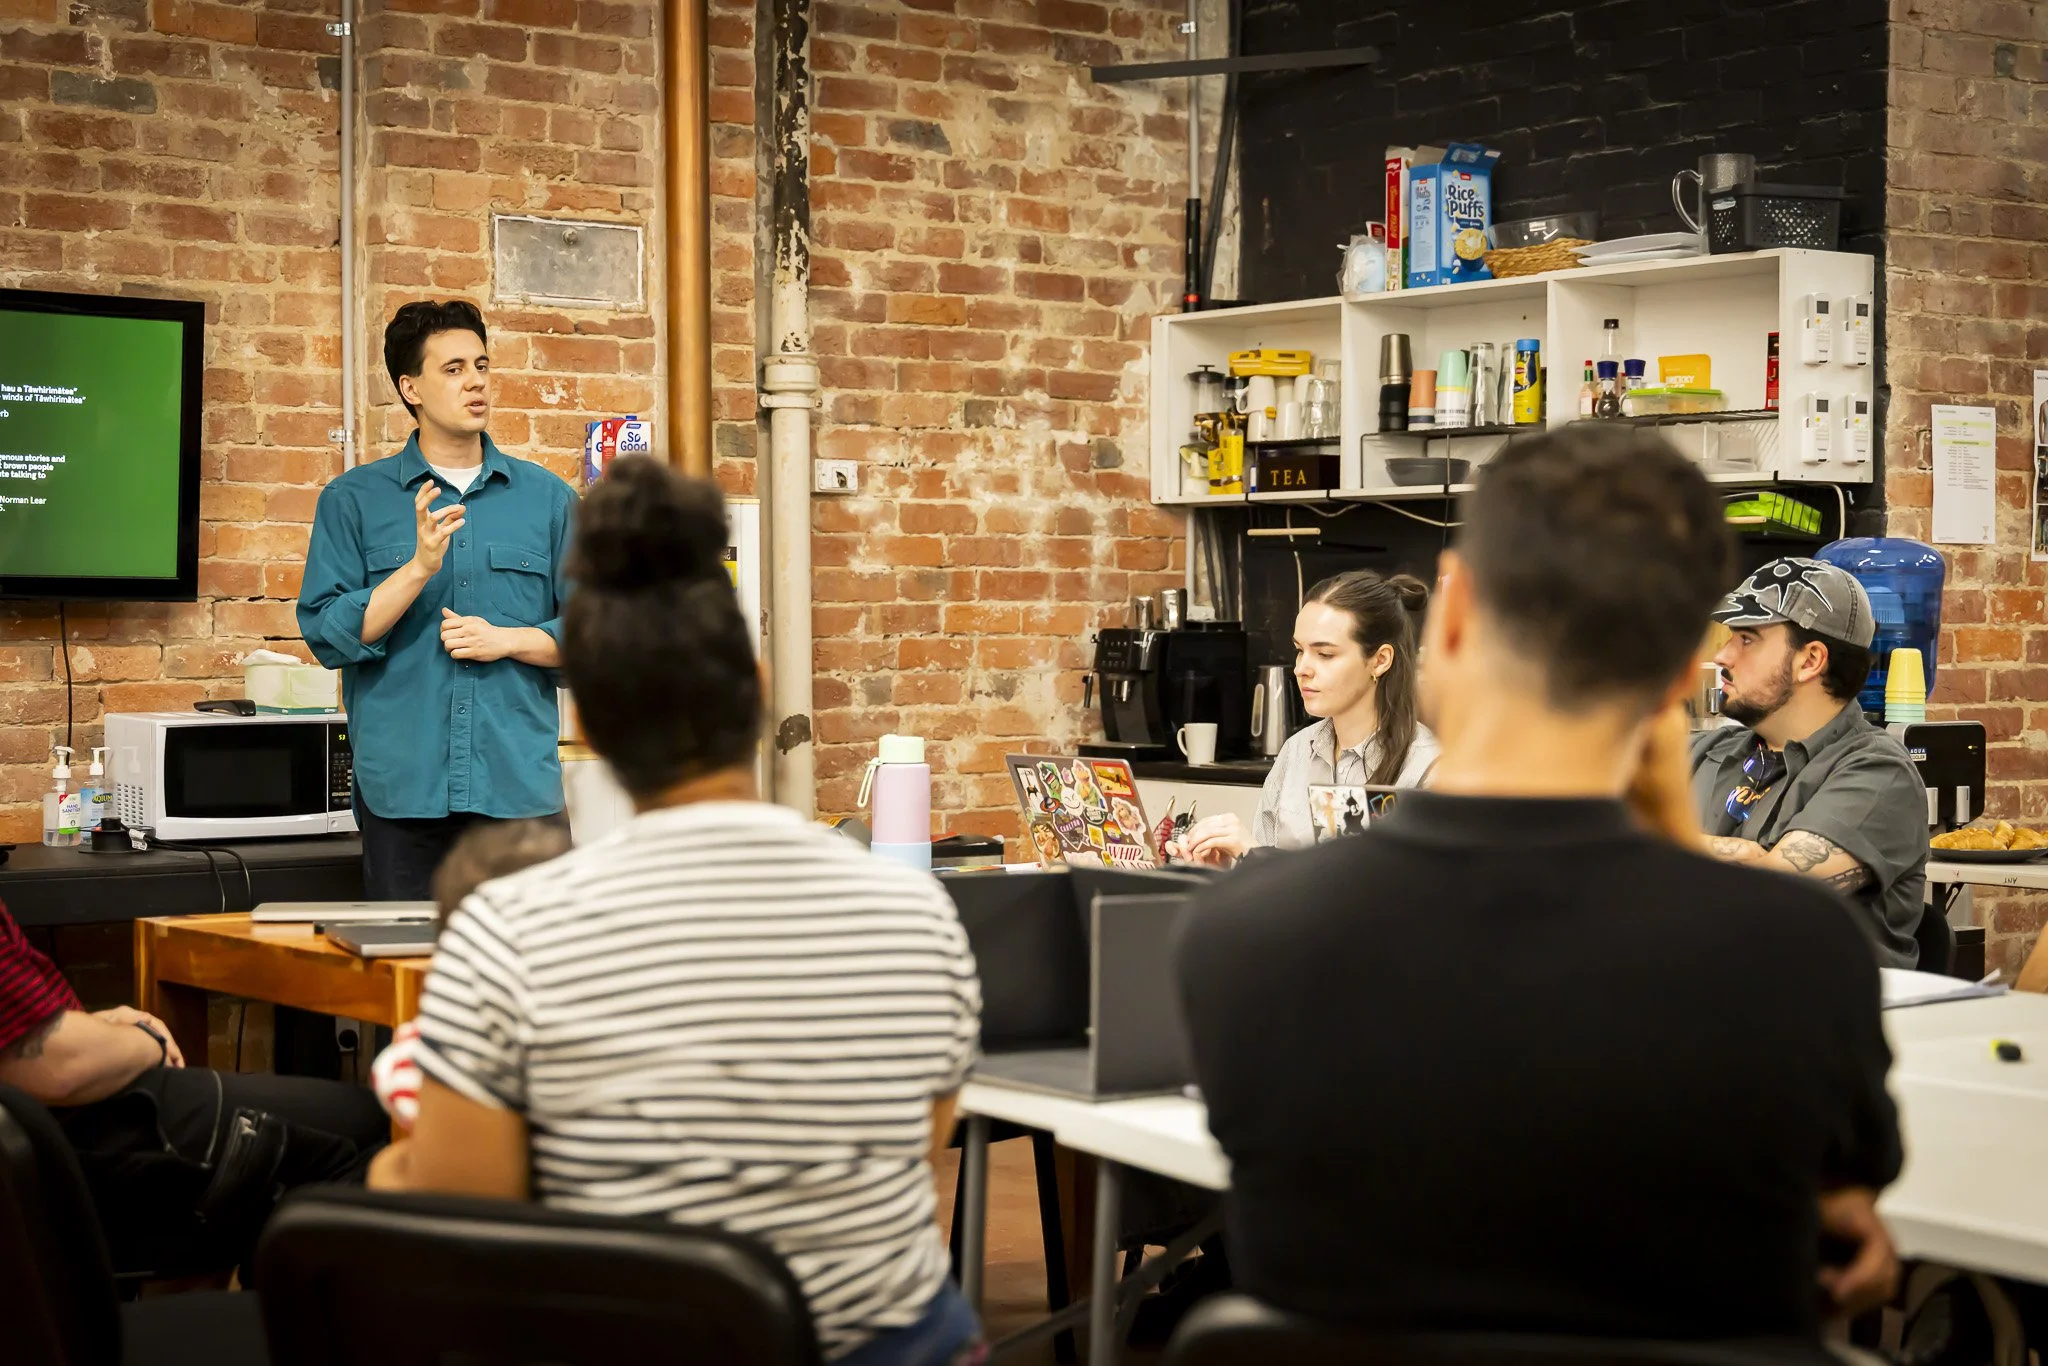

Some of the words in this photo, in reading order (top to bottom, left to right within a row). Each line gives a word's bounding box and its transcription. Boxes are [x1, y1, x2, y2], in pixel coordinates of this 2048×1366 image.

[1447, 184, 1475, 201] Rice
[1449, 200, 1485, 217] Puffs
[1, 384, 16, 392] hau
[2, 393, 23, 402] winds
[25, 394, 33, 402] of
[627, 431, 641, 442] So
[620, 440, 648, 452] Good
[25, 454, 50, 462] stories
[51, 455, 66, 463] and
[3, 462, 27, 470] brown
[28, 463, 54, 472] people
[11, 470, 37, 480] talking
[38, 471, 47, 479] to
[1270, 469, 1307, 486] TEA
[0, 495, 29, 504] Norman
[30, 496, 47, 505] Lear
[1108, 845, 1142, 861] WHIP
